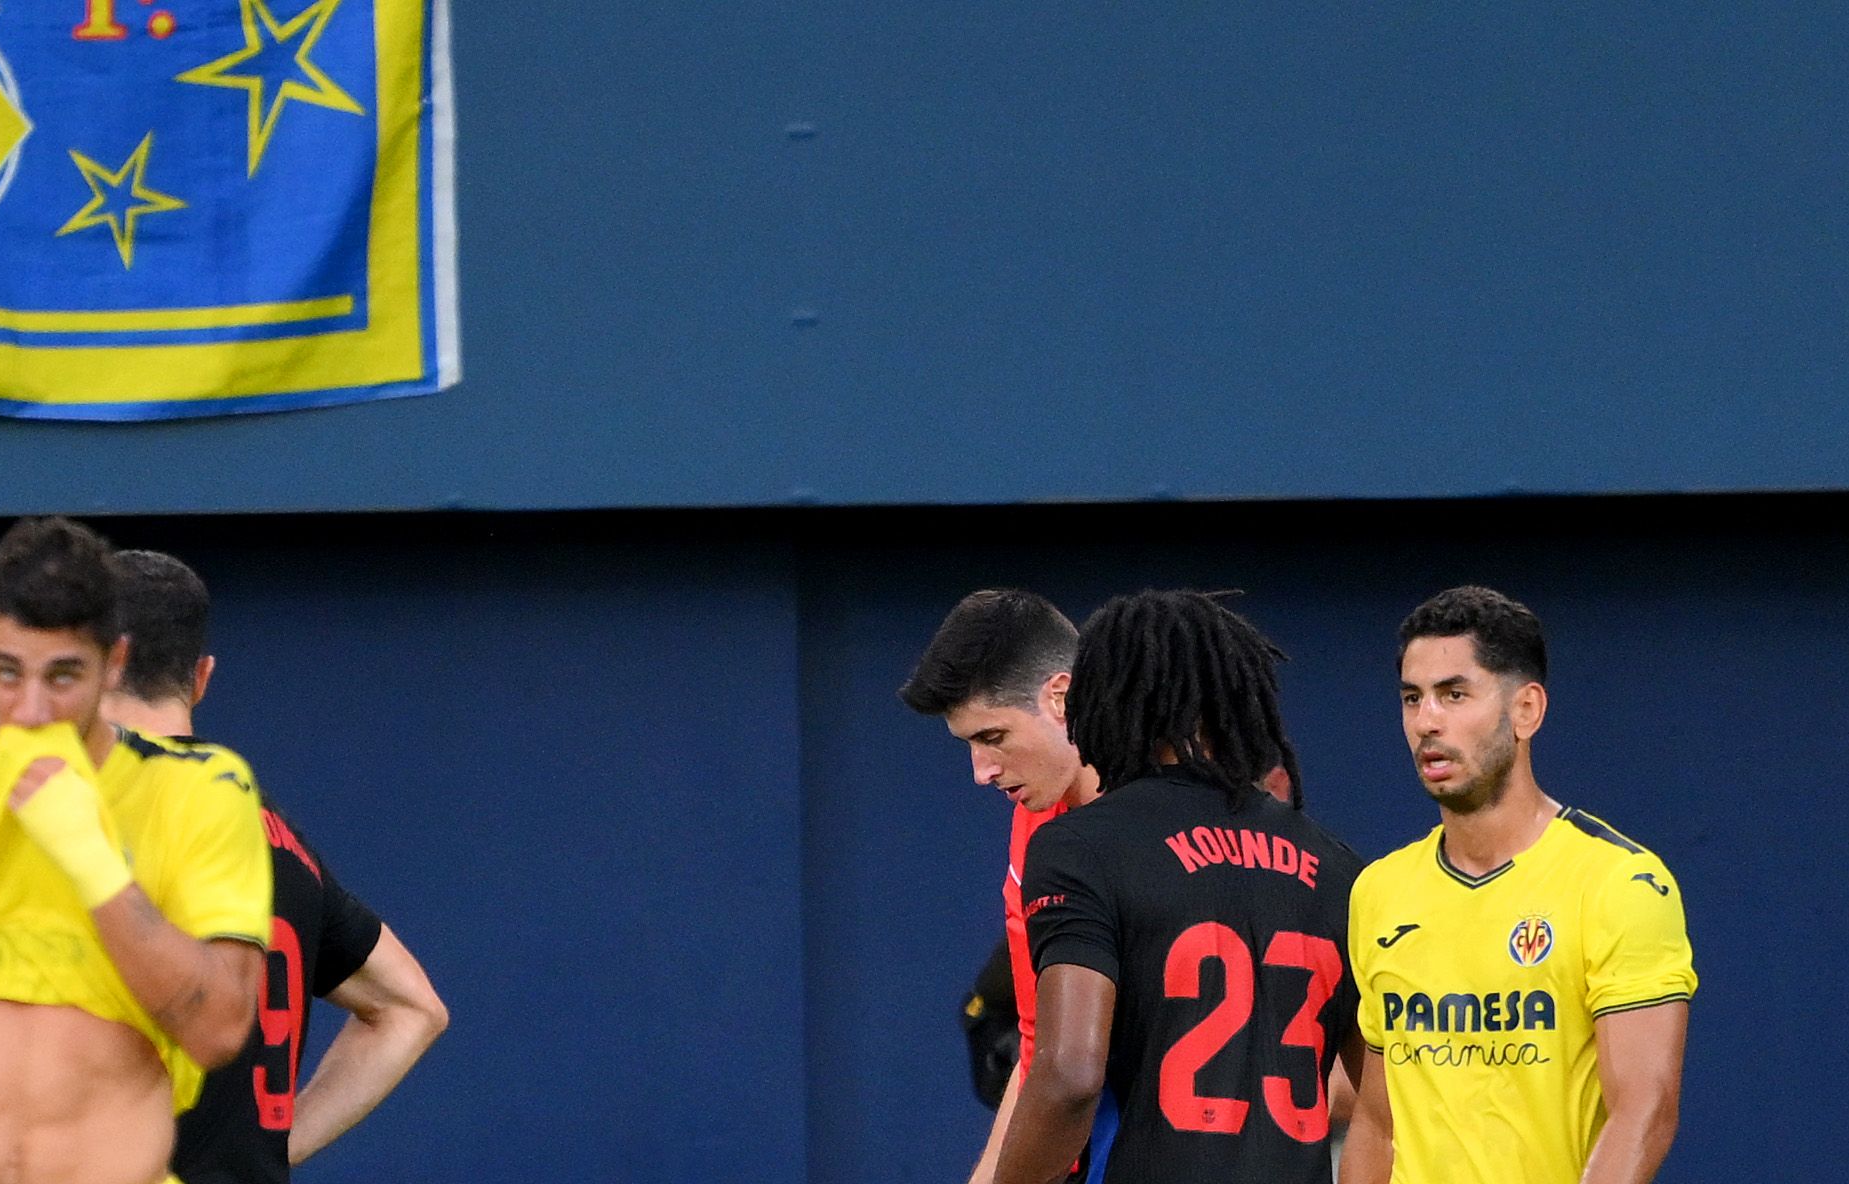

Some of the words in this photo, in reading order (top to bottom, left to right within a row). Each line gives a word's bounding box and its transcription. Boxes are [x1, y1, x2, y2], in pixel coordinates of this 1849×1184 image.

[1164, 825, 1320, 890] KOUNDE
[254, 915, 304, 1130] 9
[1158, 920, 1343, 1143] 23
[1383, 989, 1556, 1033] PAMESA
[1389, 1038, 1551, 1067] cerámica
